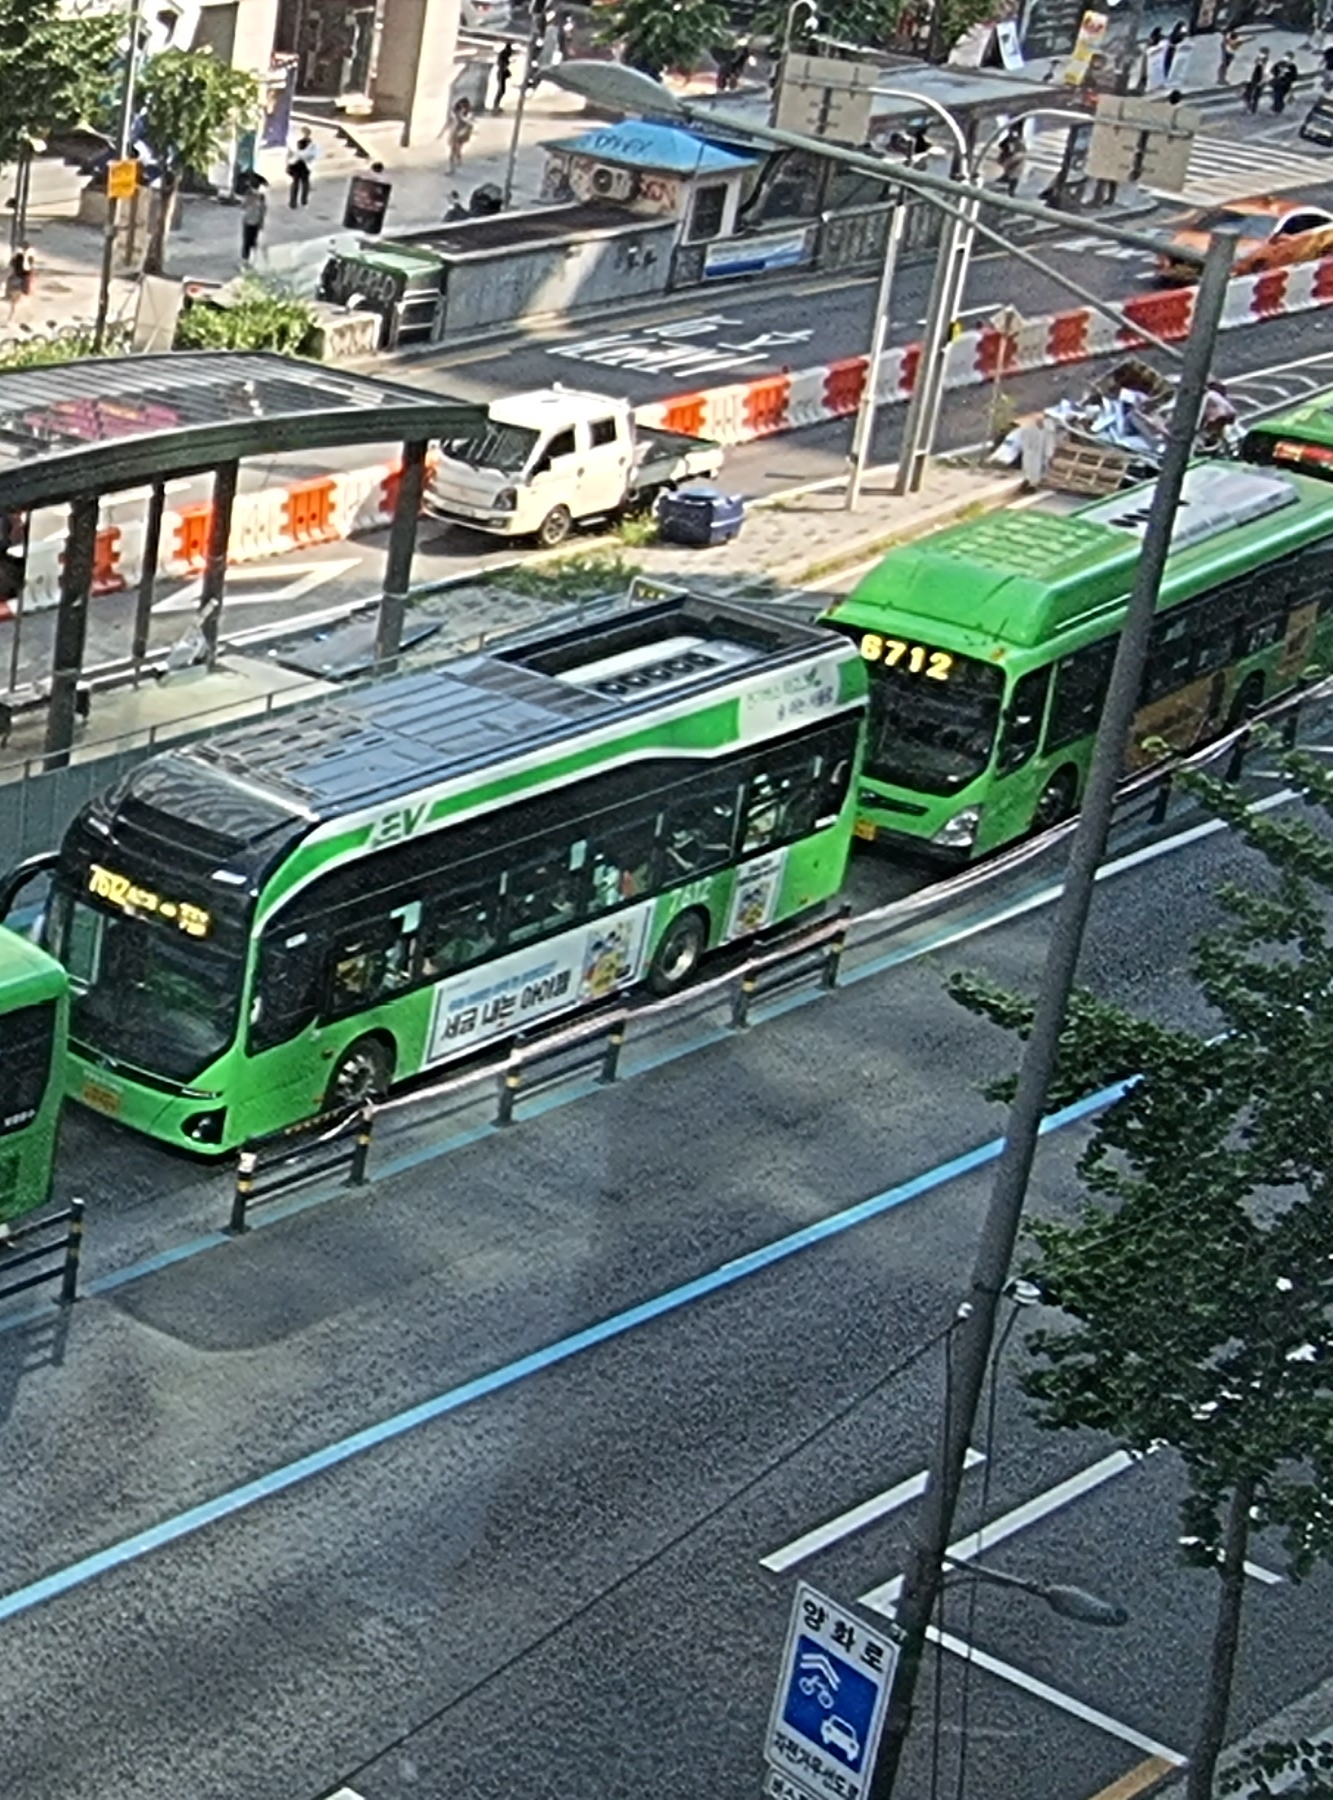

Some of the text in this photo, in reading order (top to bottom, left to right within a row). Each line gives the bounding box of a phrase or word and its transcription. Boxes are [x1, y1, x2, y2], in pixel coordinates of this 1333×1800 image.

[860, 633, 952, 680] 6712
[374, 802, 426, 847] EV
[803, 1600, 884, 1674] 양화로
